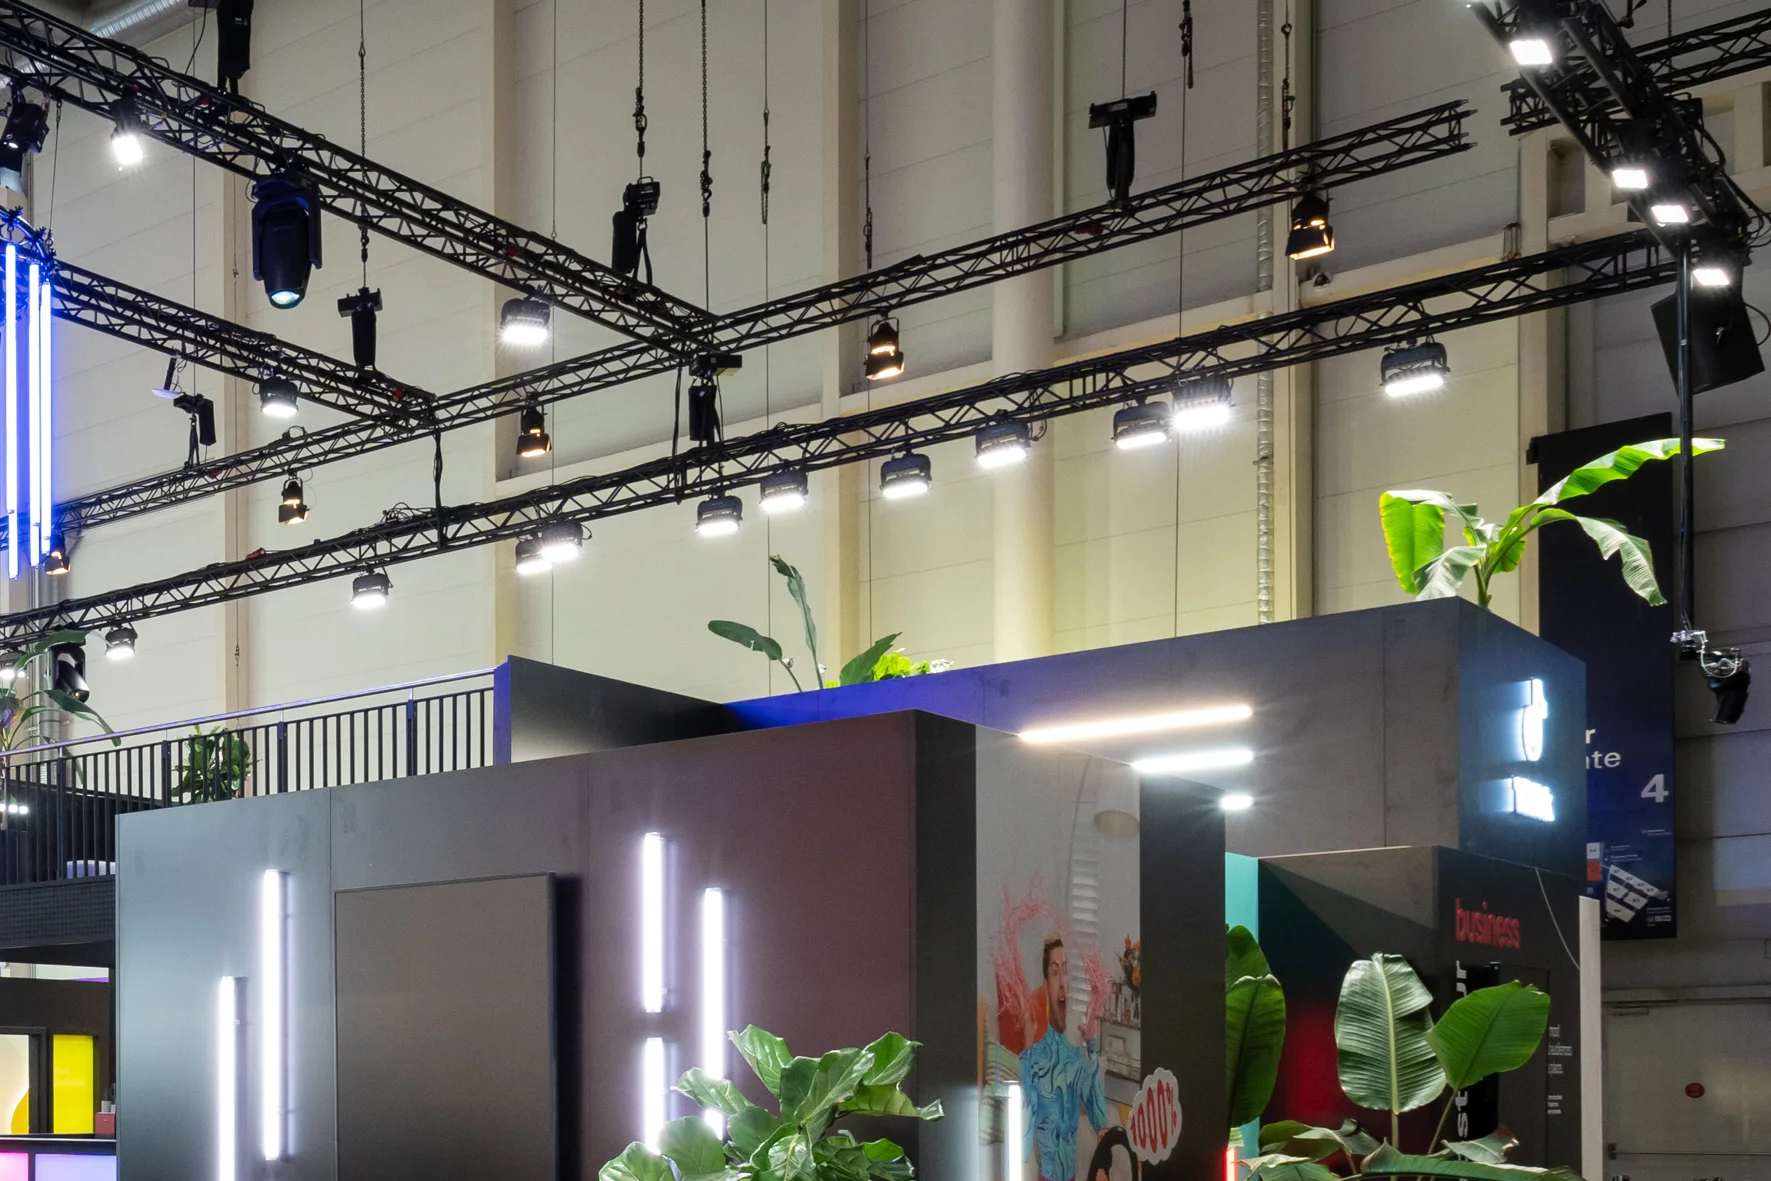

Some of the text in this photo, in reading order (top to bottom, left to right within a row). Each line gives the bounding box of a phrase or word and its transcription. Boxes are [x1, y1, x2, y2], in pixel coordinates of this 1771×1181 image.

[1641, 774, 1669, 803] 4
[1454, 898, 1521, 950] business
[1130, 1079, 1177, 1153] 1000%
